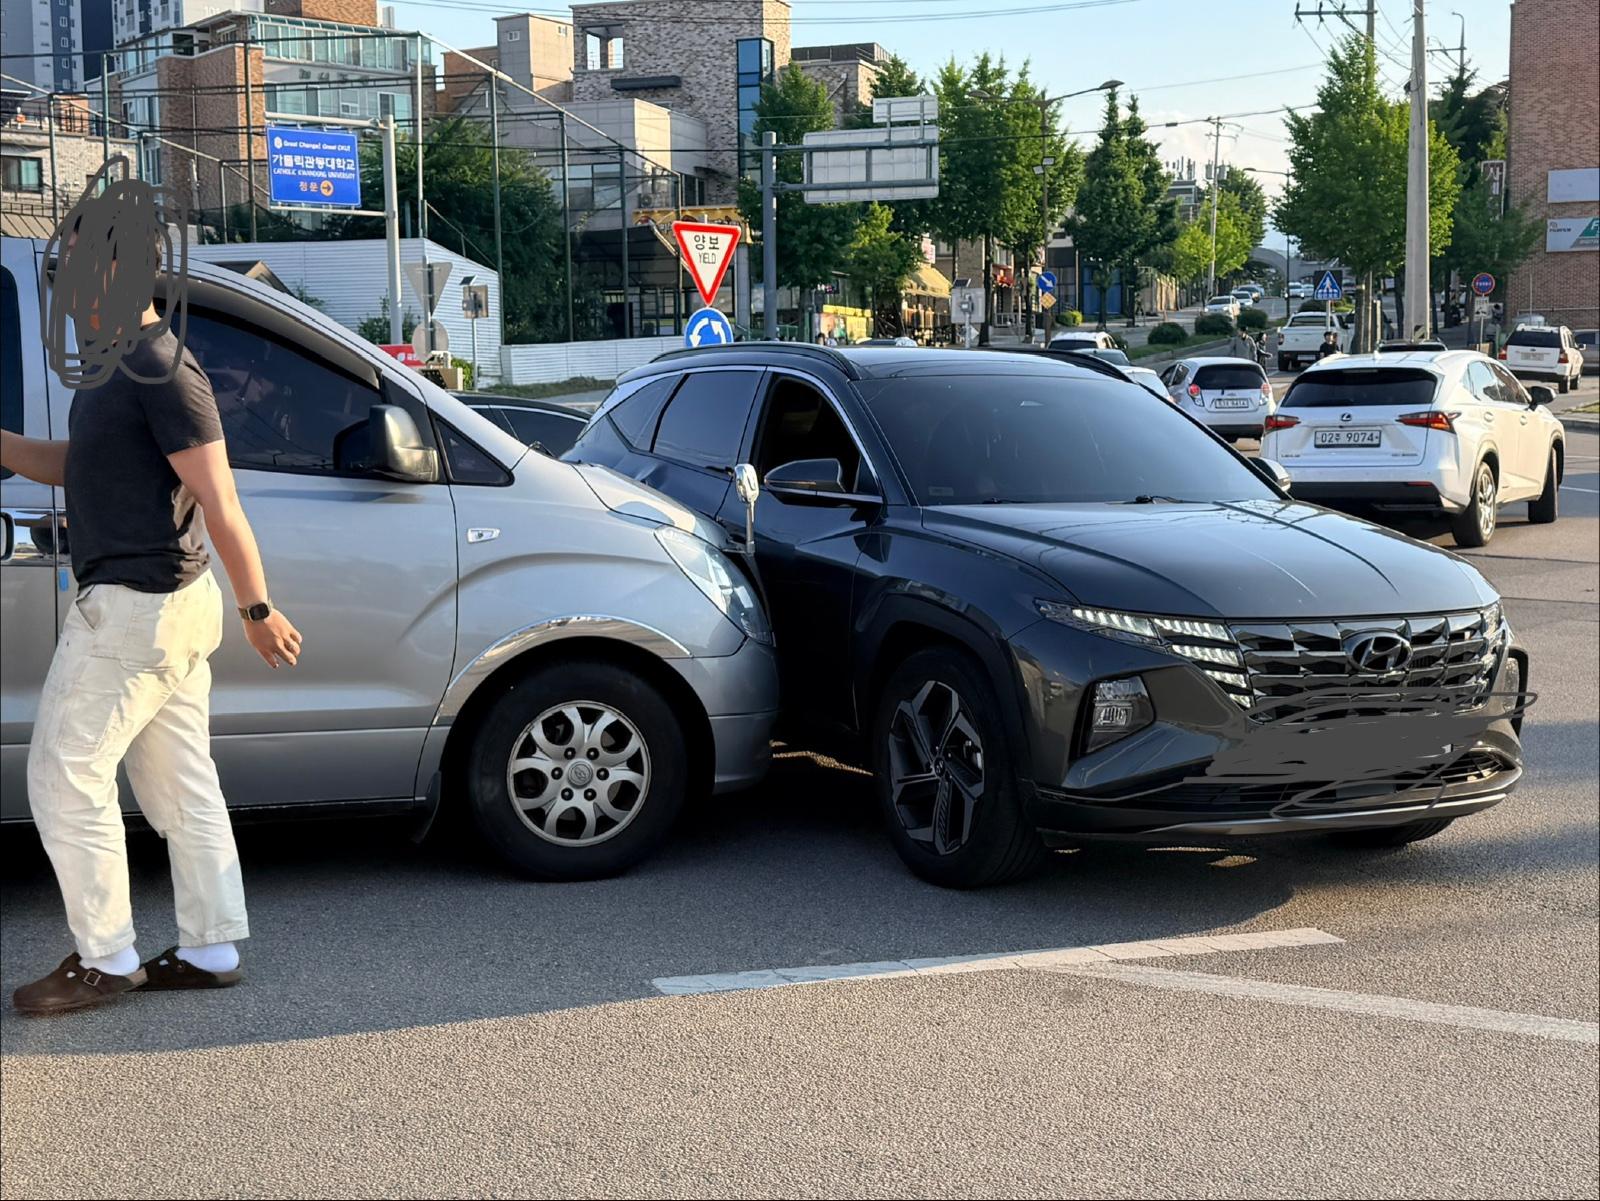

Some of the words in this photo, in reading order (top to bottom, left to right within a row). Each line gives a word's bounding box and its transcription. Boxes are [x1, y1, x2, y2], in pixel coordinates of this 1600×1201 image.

[272, 154, 356, 171] 가톨릭관동대학교
[273, 167, 297, 176] CATHOLIC
[297, 169, 327, 178] KWANDONG
[327, 171, 356, 180] UNIVERSITY
[694, 234, 719, 250] 양보
[698, 252, 717, 264] YIELD
[1346, 432, 1374, 442] 9074
